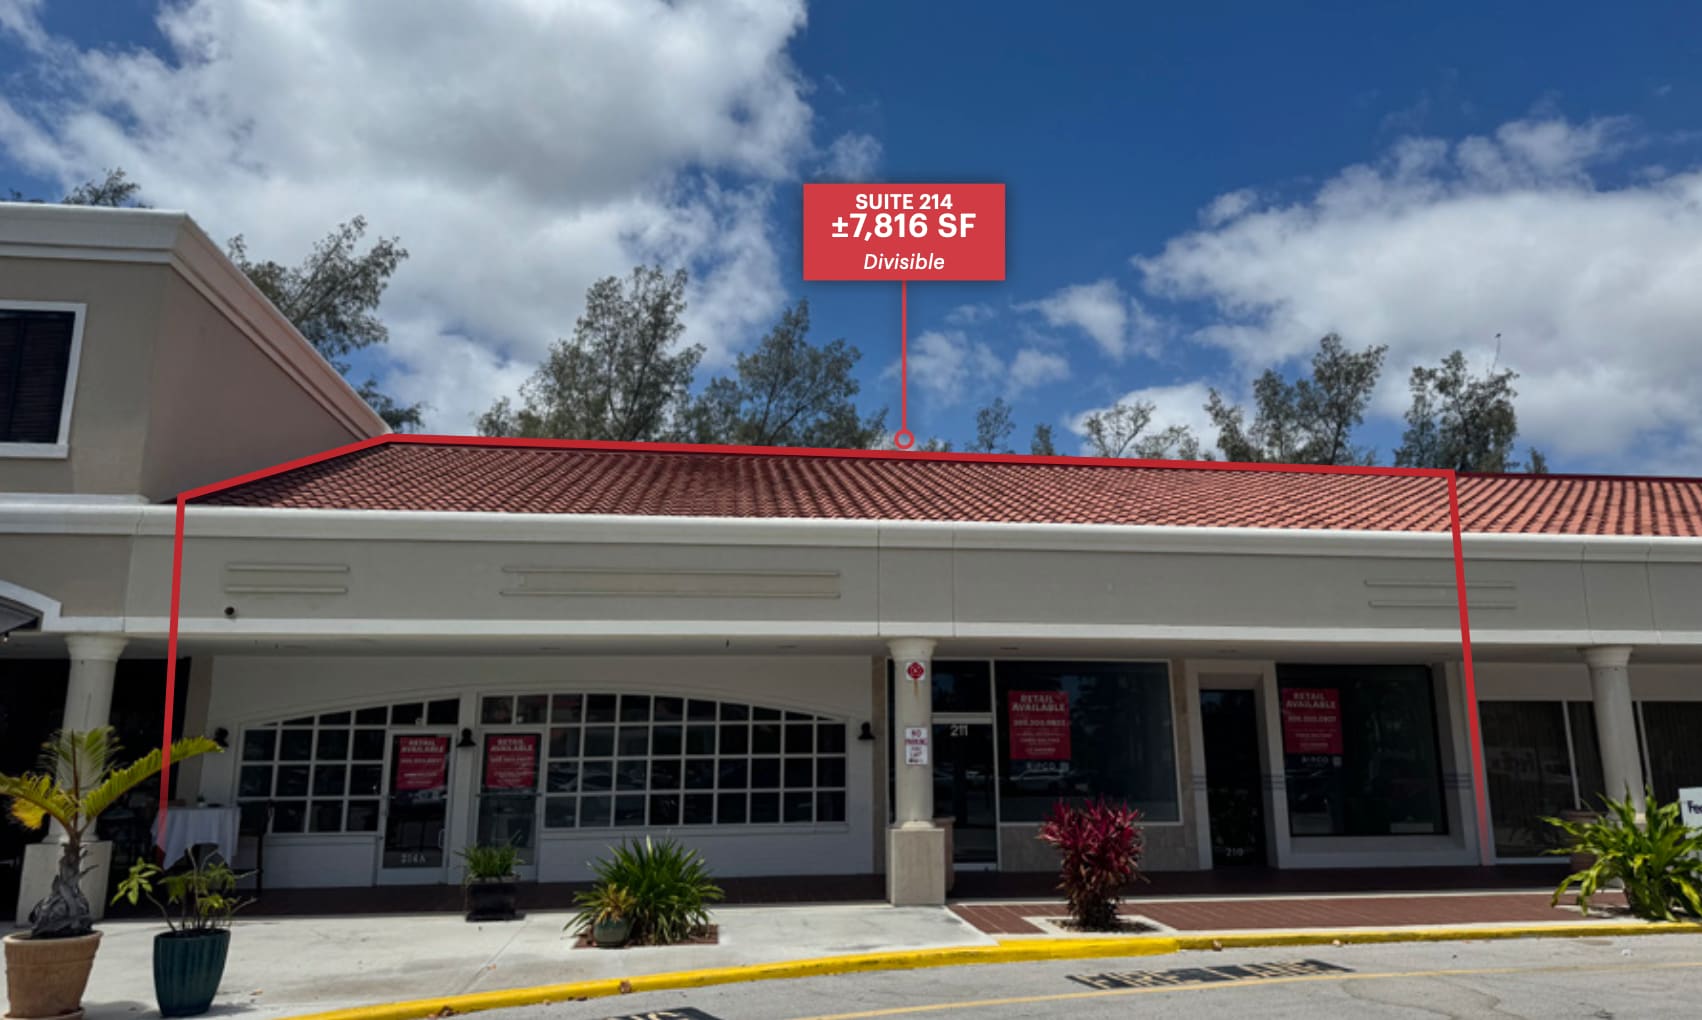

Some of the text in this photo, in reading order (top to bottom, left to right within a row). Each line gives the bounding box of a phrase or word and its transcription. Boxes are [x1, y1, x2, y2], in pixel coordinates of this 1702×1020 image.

[1020, 694, 1054, 703] RETAIL
[1292, 691, 1325, 700] RETAIL
[1012, 703, 1066, 712] AVAILABLE
[1286, 700, 1337, 709] AVAILABLE
[949, 724, 968, 737] 211
